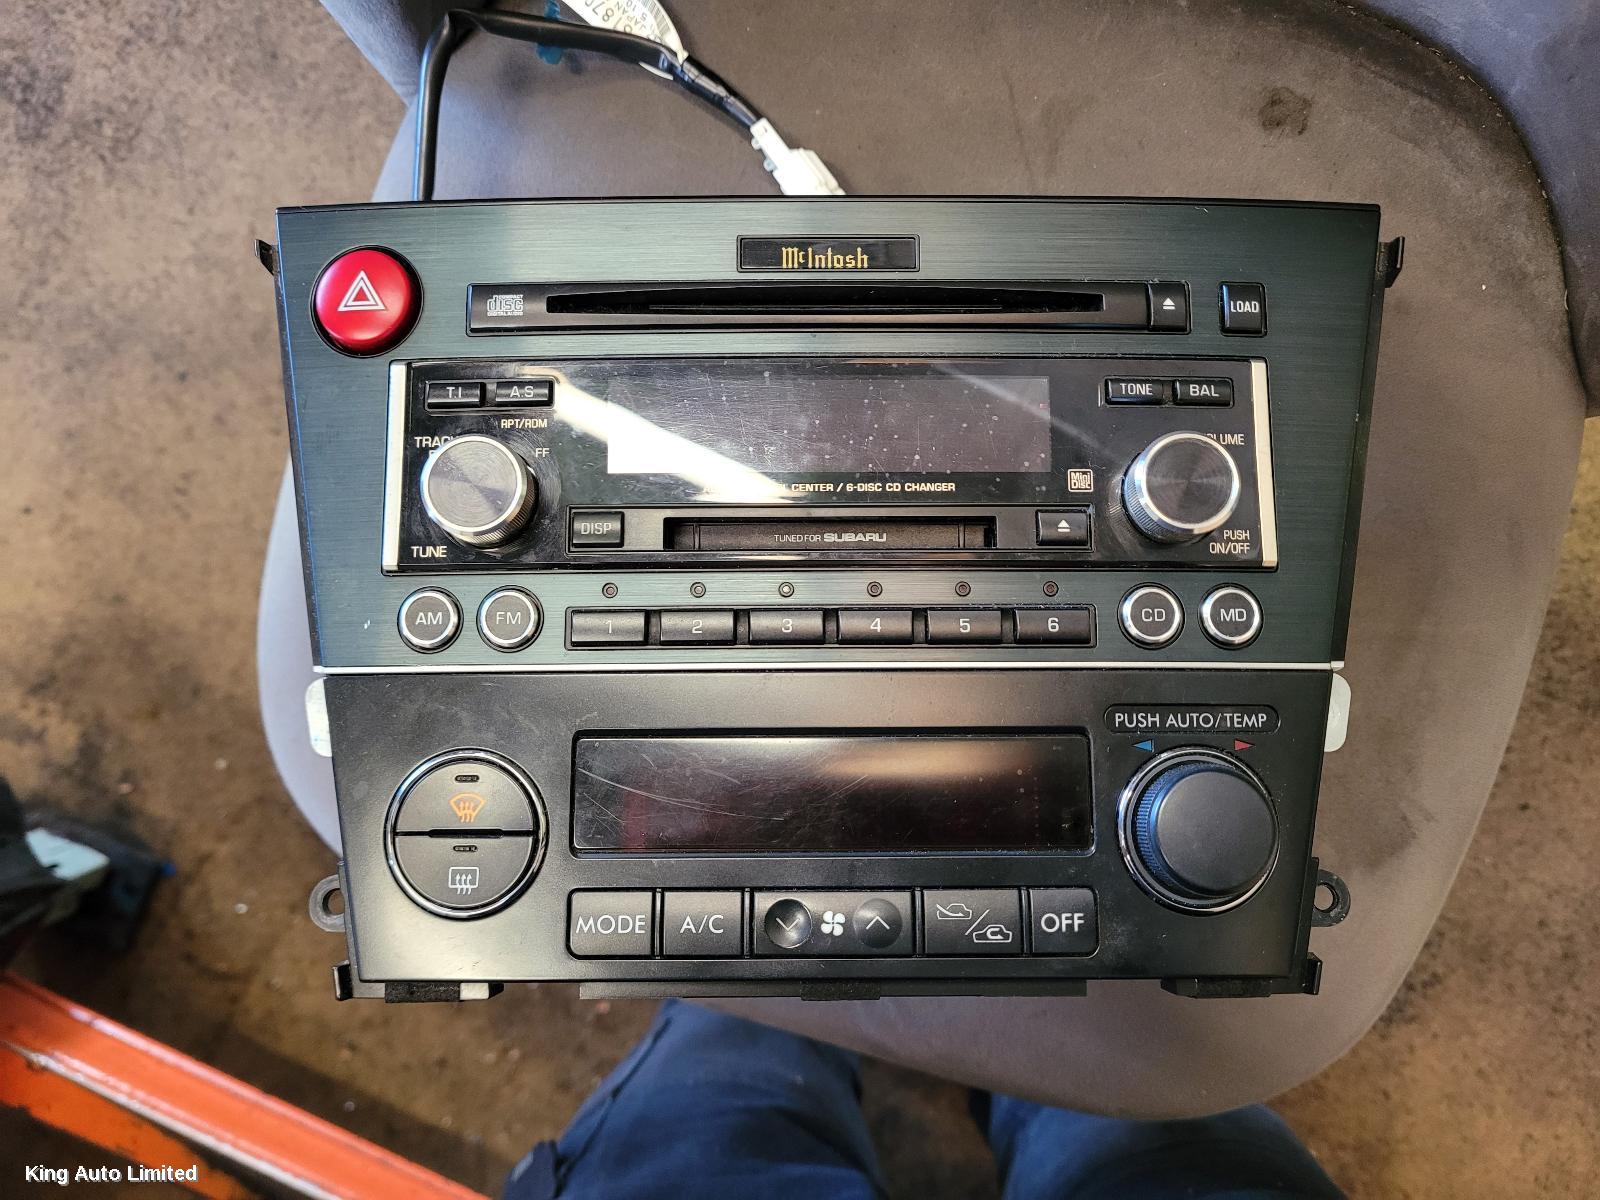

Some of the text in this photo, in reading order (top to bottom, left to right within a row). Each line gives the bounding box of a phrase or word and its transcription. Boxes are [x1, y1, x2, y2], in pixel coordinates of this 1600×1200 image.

[781, 246, 869, 269] McIntosh
[1230, 300, 1260, 313] LOAD
[509, 385, 534, 398] A.S
[1119, 383, 1153, 395] TONE
[1189, 384, 1219, 397] BAL
[500, 419, 548, 429] RPT/RDM
[414, 436, 454, 449] TRAC
[535, 447, 550, 458] FF
[1070, 472, 1091, 482] Mini
[791, 483, 834, 492] CENTER
[846, 483, 882, 492] 6-DISC
[885, 483, 902, 492] CD
[904, 483, 956, 492] CHANGER
[580, 522, 612, 535] DISP
[1223, 530, 1250, 540] PUSH
[774, 532, 887, 543] TUNED FOR SUBARU
[411, 546, 447, 558] TUNE
[1209, 543, 1250, 554] ON/OFF
[415, 612, 443, 625] AM
[495, 611, 521, 625] FM
[1141, 608, 1166, 622] CD
[1220, 608, 1247, 621] MD
[604, 620, 613, 634] 1
[691, 619, 703, 634] 2
[781, 618, 793, 633] 3
[870, 617, 882, 632] 4
[959, 618, 971, 633] 5
[1047, 617, 1060, 632] 6
[1115, 713, 1267, 728] PUSH AUTO/TEMP
[575, 914, 646, 934] MODE
[679, 914, 724, 934] A/C
[1040, 912, 1085, 933] OFF
